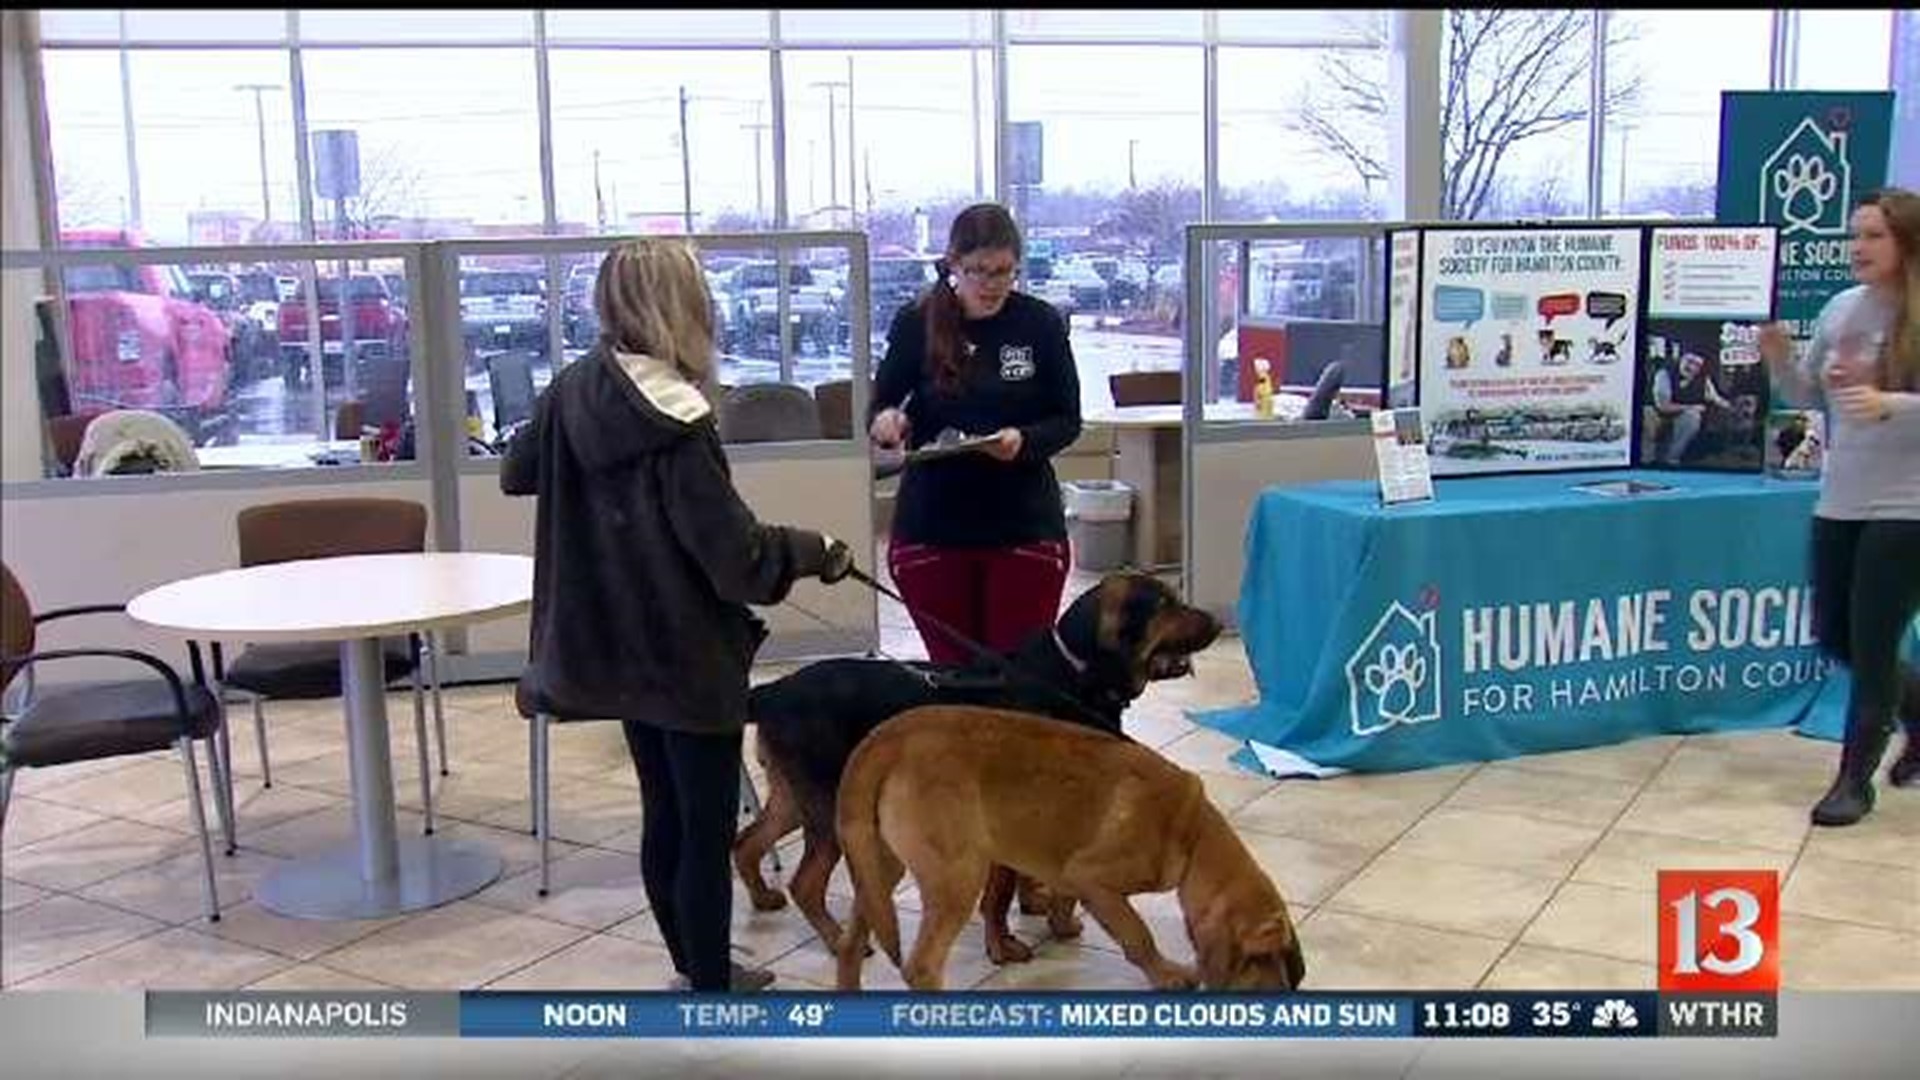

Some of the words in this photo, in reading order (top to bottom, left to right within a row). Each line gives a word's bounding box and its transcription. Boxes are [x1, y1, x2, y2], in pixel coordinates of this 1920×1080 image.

[1502, 235, 1536, 253] KNOW
[1565, 234, 1614, 251] HUMANE
[1658, 234, 1699, 251] FUNDS
[1439, 256, 1487, 274] SOCIETY
[1491, 256, 1513, 273] FOR
[1516, 255, 1574, 272] HAMILTON
[1463, 590, 1671, 673] HUMANE
[1463, 685, 1533, 716] FOR
[1551, 664, 1726, 708] HAMILTON
